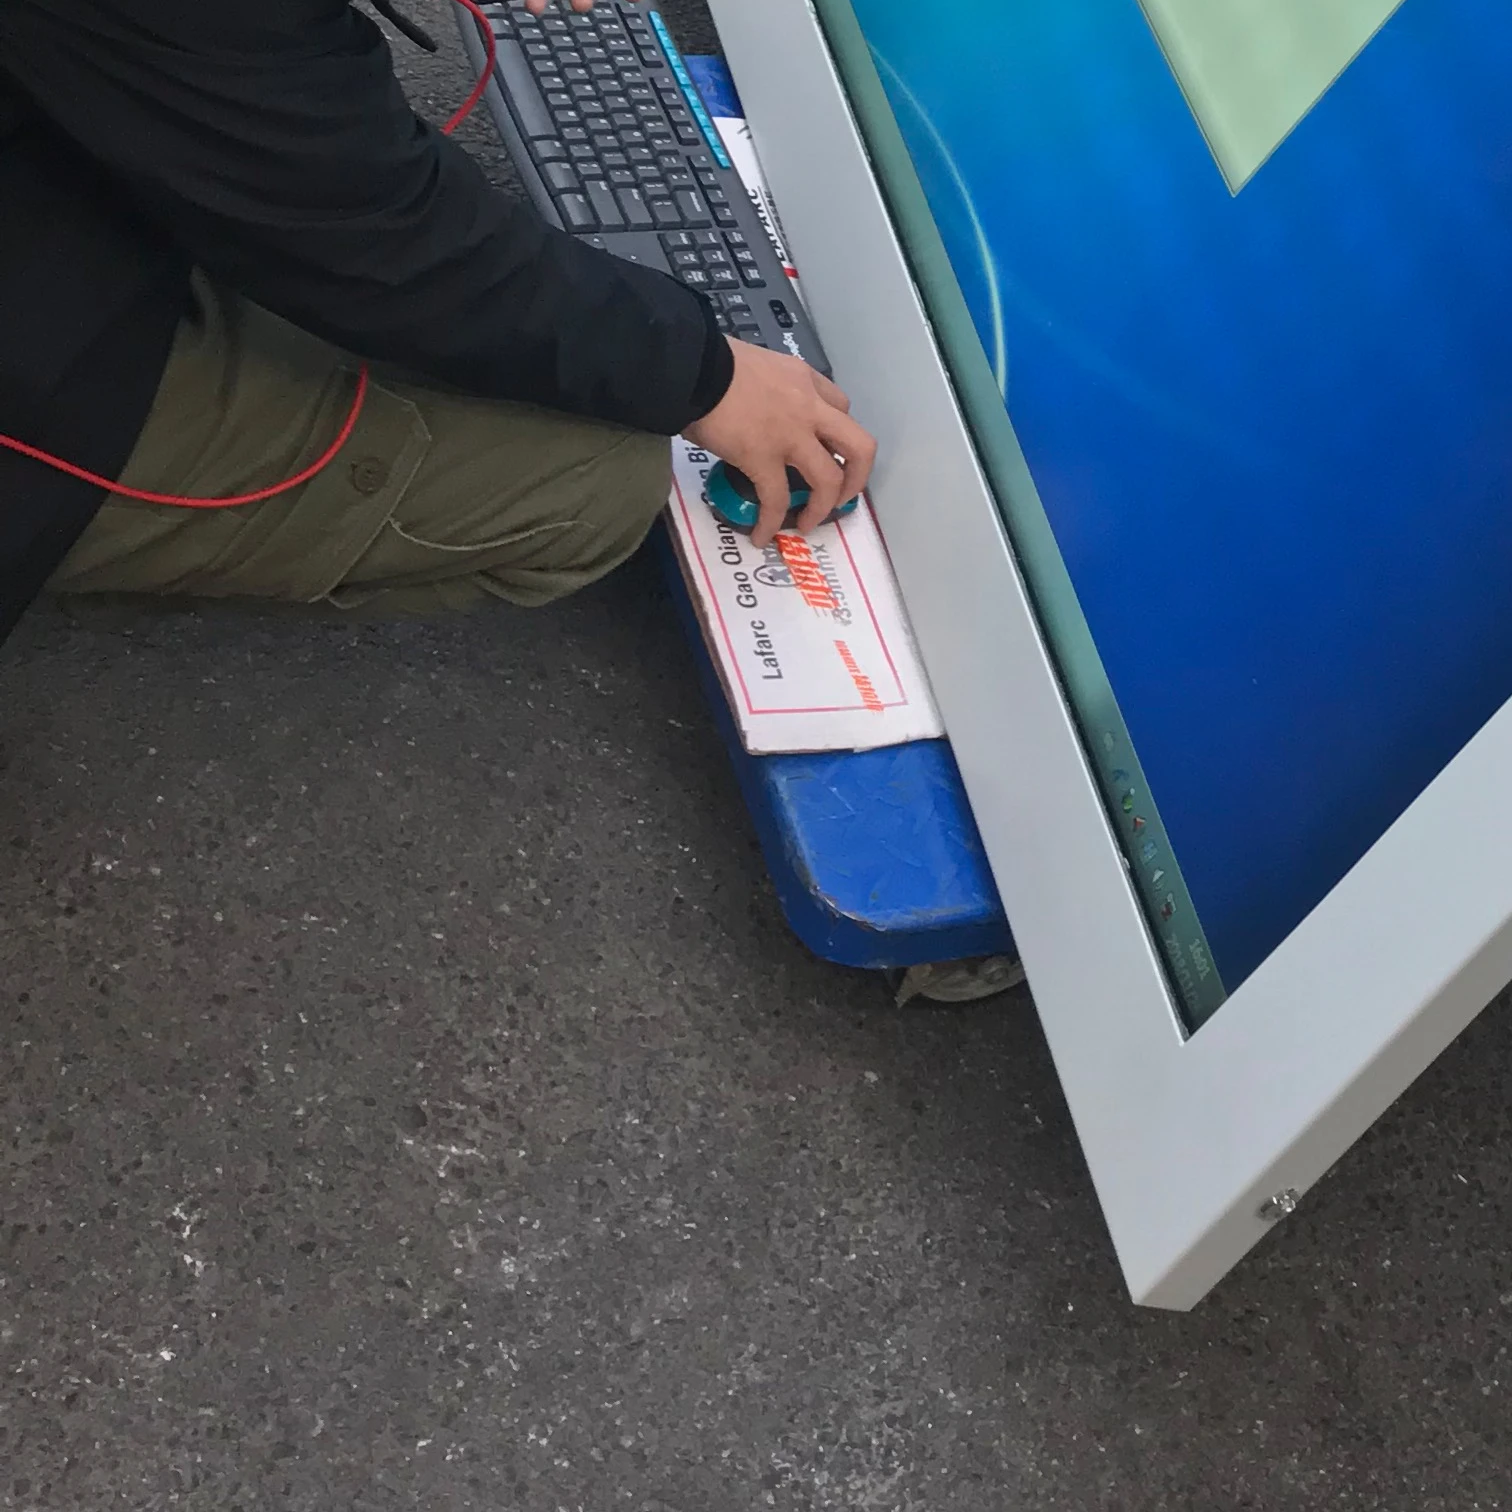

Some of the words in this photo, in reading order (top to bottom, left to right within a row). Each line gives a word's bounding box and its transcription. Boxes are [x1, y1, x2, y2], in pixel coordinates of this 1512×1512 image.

[713, 515, 743, 566] Qian
[733, 571, 758, 609] Gao
[749, 617, 784, 680] Lafarc
